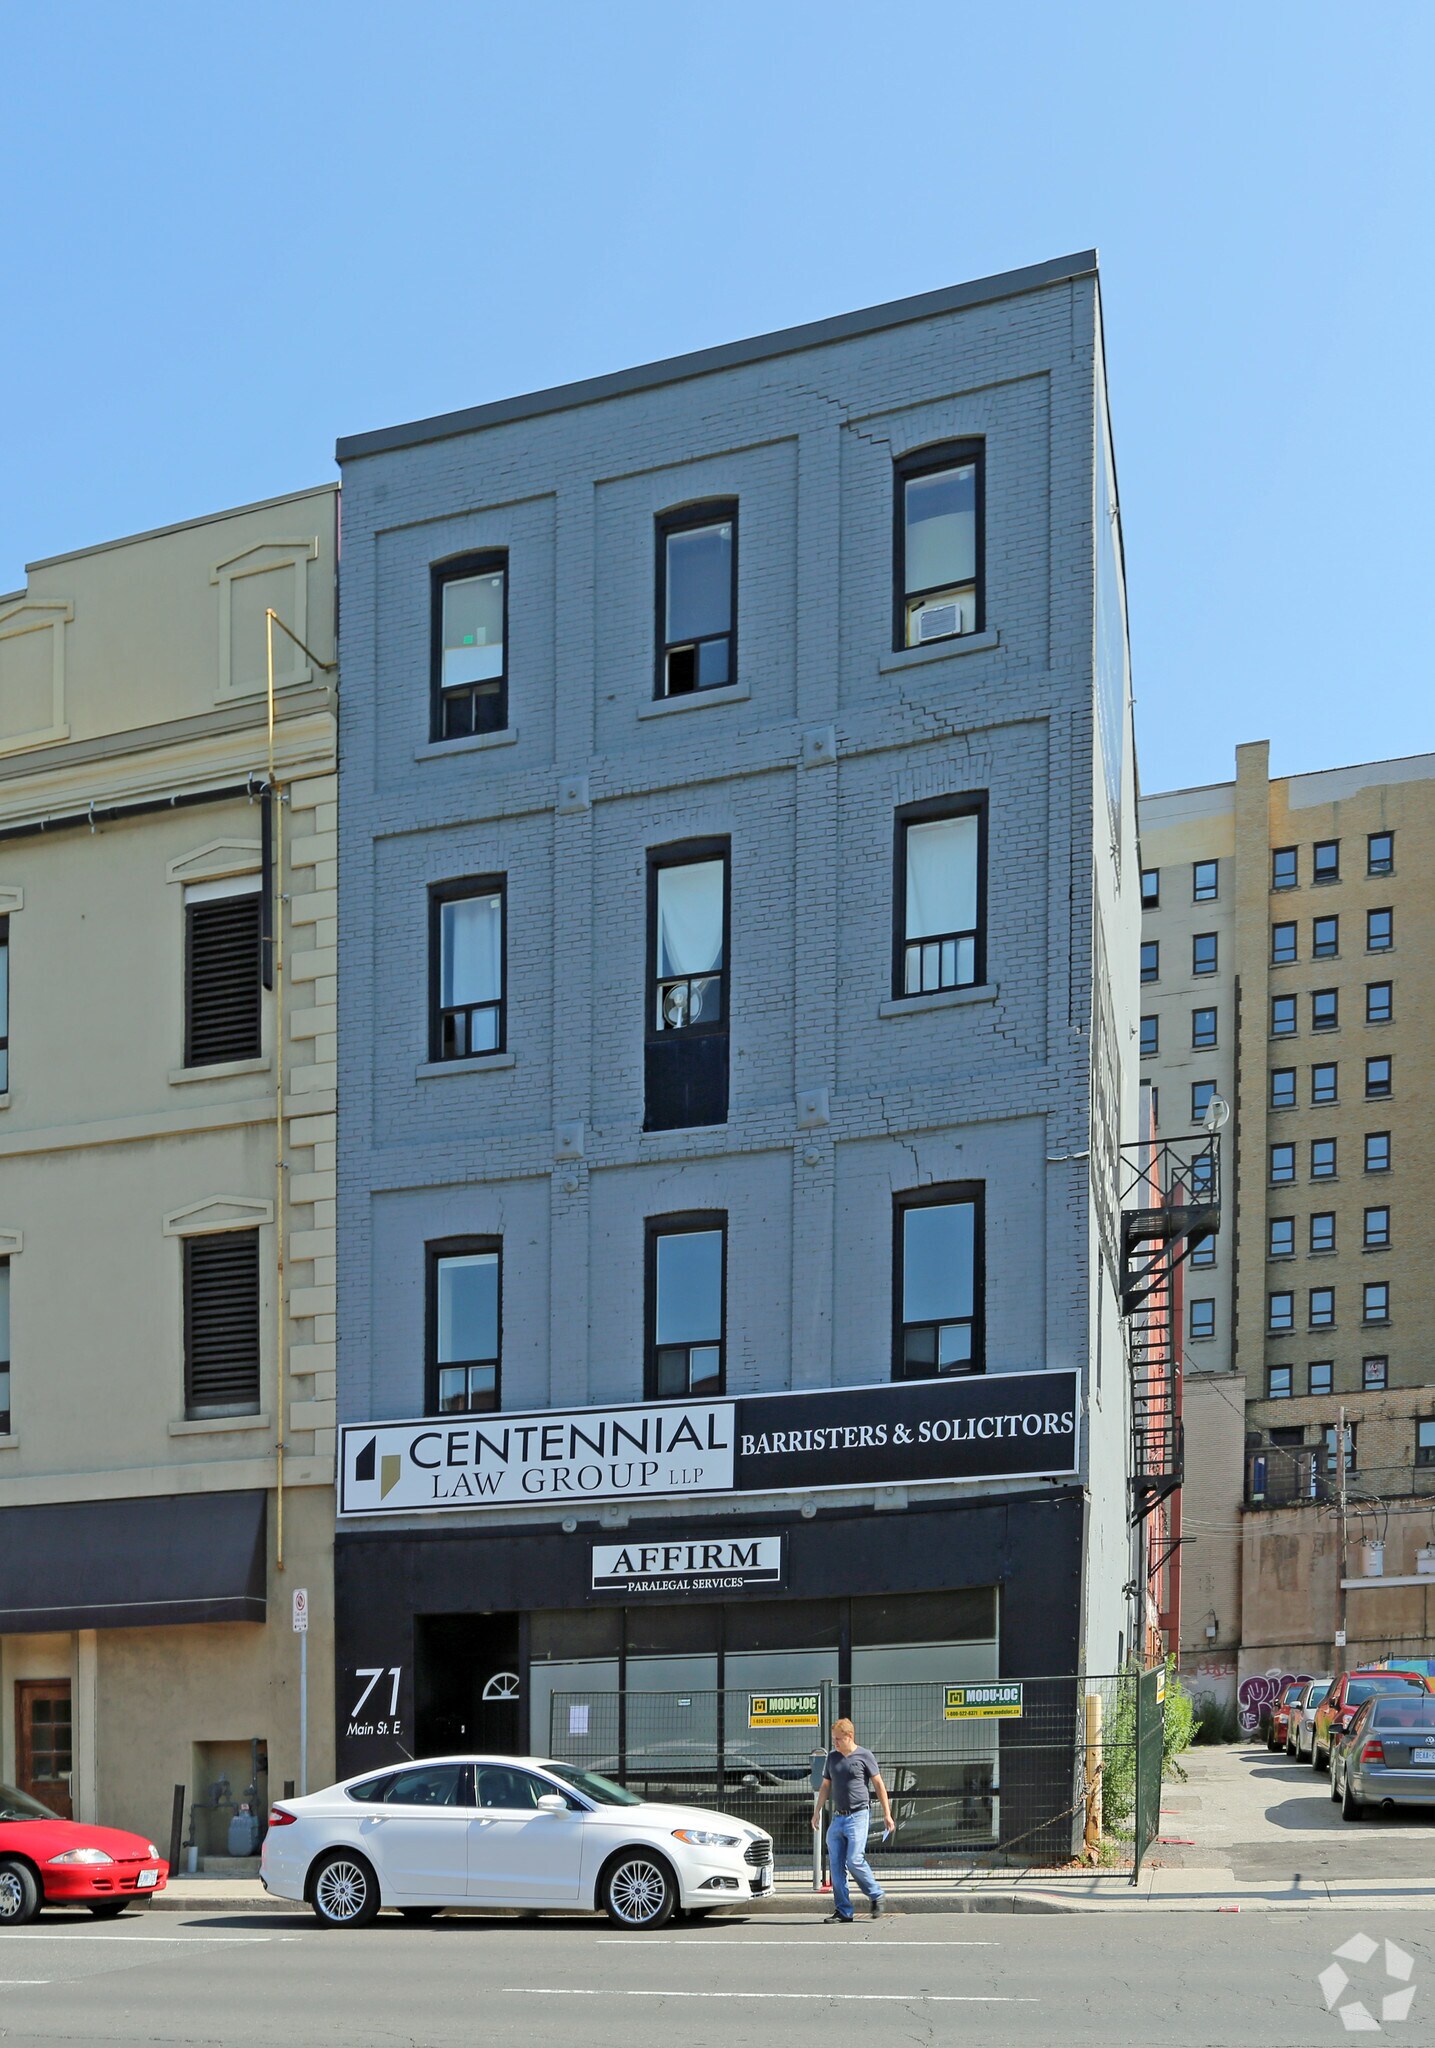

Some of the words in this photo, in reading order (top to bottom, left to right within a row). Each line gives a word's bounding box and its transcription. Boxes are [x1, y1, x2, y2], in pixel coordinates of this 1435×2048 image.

[410, 1413, 728, 1468] CENTENNIAL
[741, 1423, 887, 1456] BARRISTERS
[892, 1423, 915, 1444] &
[918, 1411, 1074, 1443] SOLICITORS
[432, 1470, 505, 1499] LAW
[521, 1461, 659, 1494] GROUP
[669, 1467, 704, 1485] LLP
[610, 1542, 762, 1574] AFFIRM
[627, 1579, 690, 1592] PARALEGAL
[692, 1577, 743, 1589] SERVICES
[351, 1667, 401, 1718] 71
[346, 1721, 374, 1736] Main
[376, 1721, 390, 1735] St.
